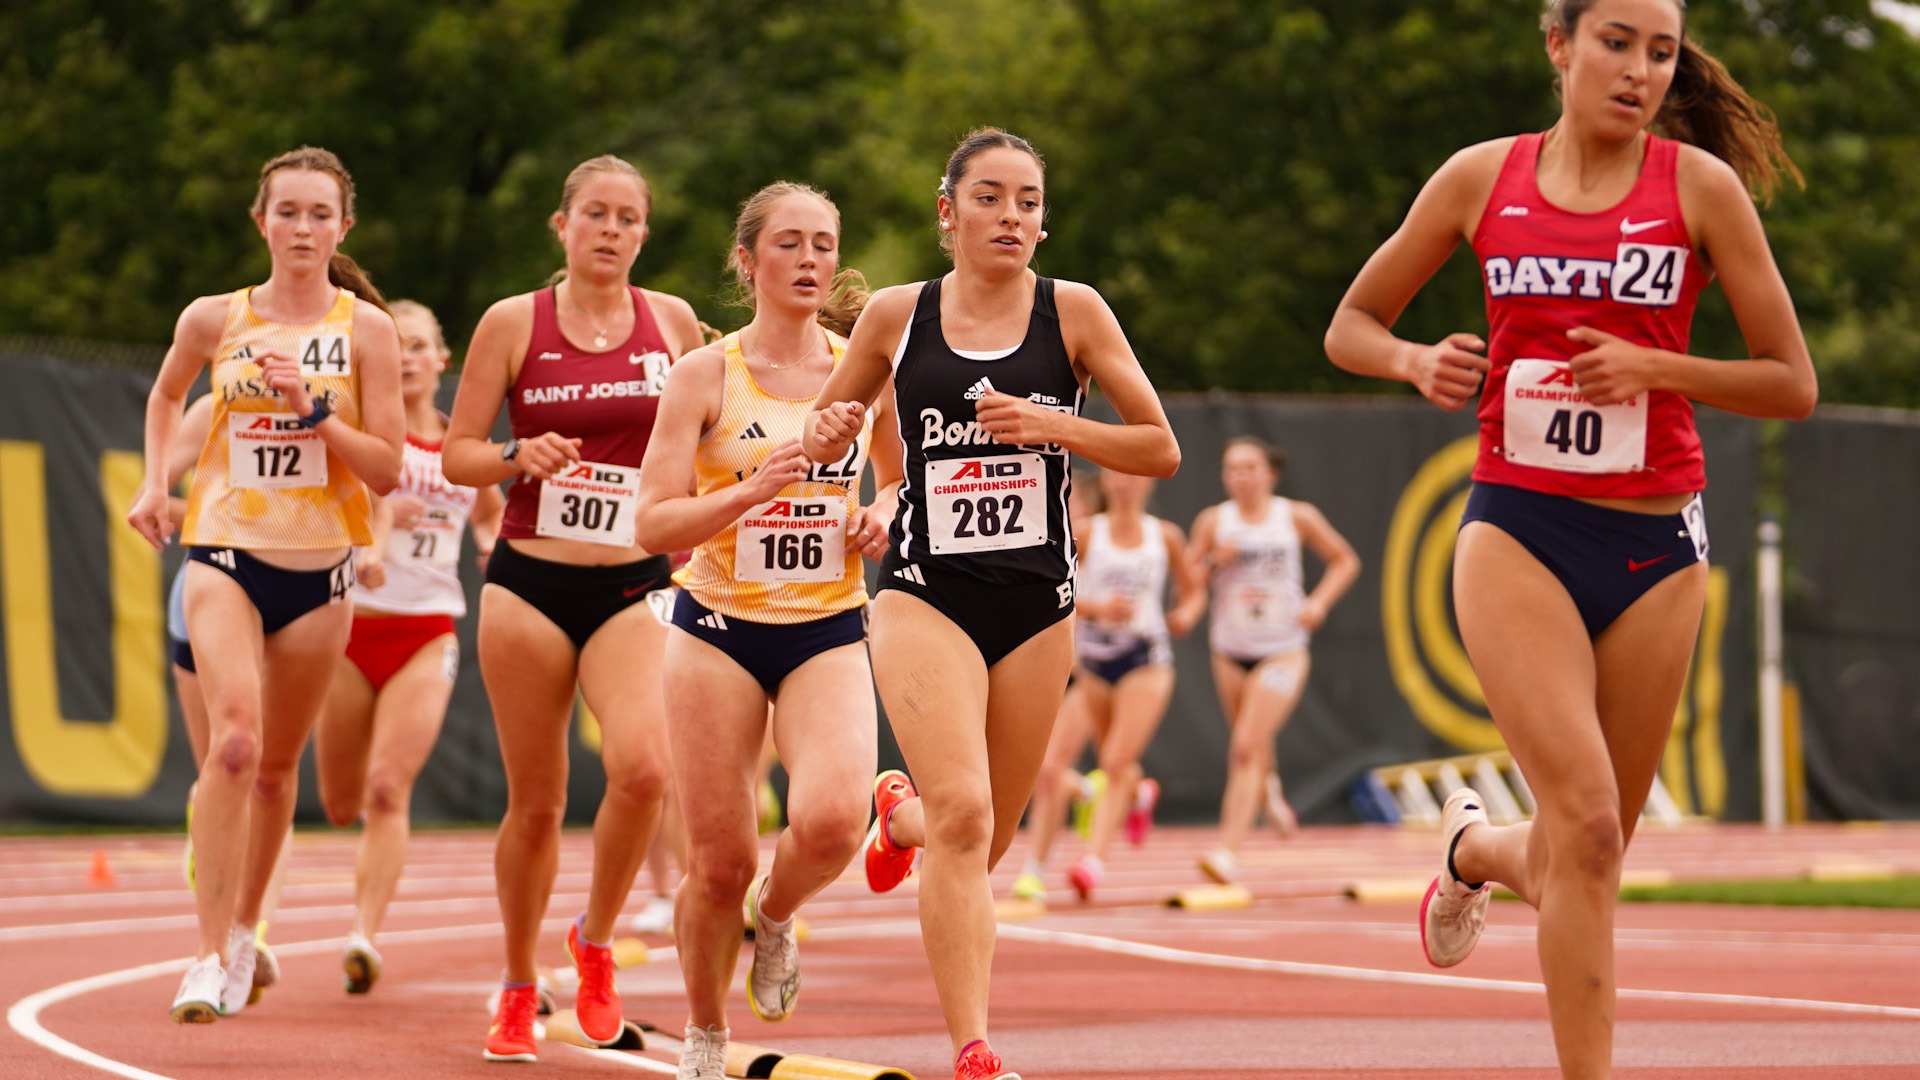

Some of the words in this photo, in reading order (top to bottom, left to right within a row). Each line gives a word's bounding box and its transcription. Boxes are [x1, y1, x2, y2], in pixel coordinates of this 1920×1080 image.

[1485, 257, 1618, 297] DAYT
[1619, 248, 1676, 299] 24
[302, 338, 347, 372] 44
[523, 385, 583, 404] SAINT
[1026, 392, 1057, 404] A10
[235, 431, 318, 441] CHAMPIONSHIPS
[1545, 409, 1602, 455] 40
[253, 445, 302, 477] 172
[950, 461, 1022, 480] A10
[566, 466, 624, 484] A10
[550, 480, 633, 496] CHAMPIONSHIPS
[934, 479, 1037, 495] CHAMPIONSHIPS
[561, 495, 619, 531] 307
[761, 501, 826, 517] A10
[952, 495, 1023, 538] 282
[745, 519, 839, 529] CHAMPIONSHIPS
[760, 533, 823, 570] 166
